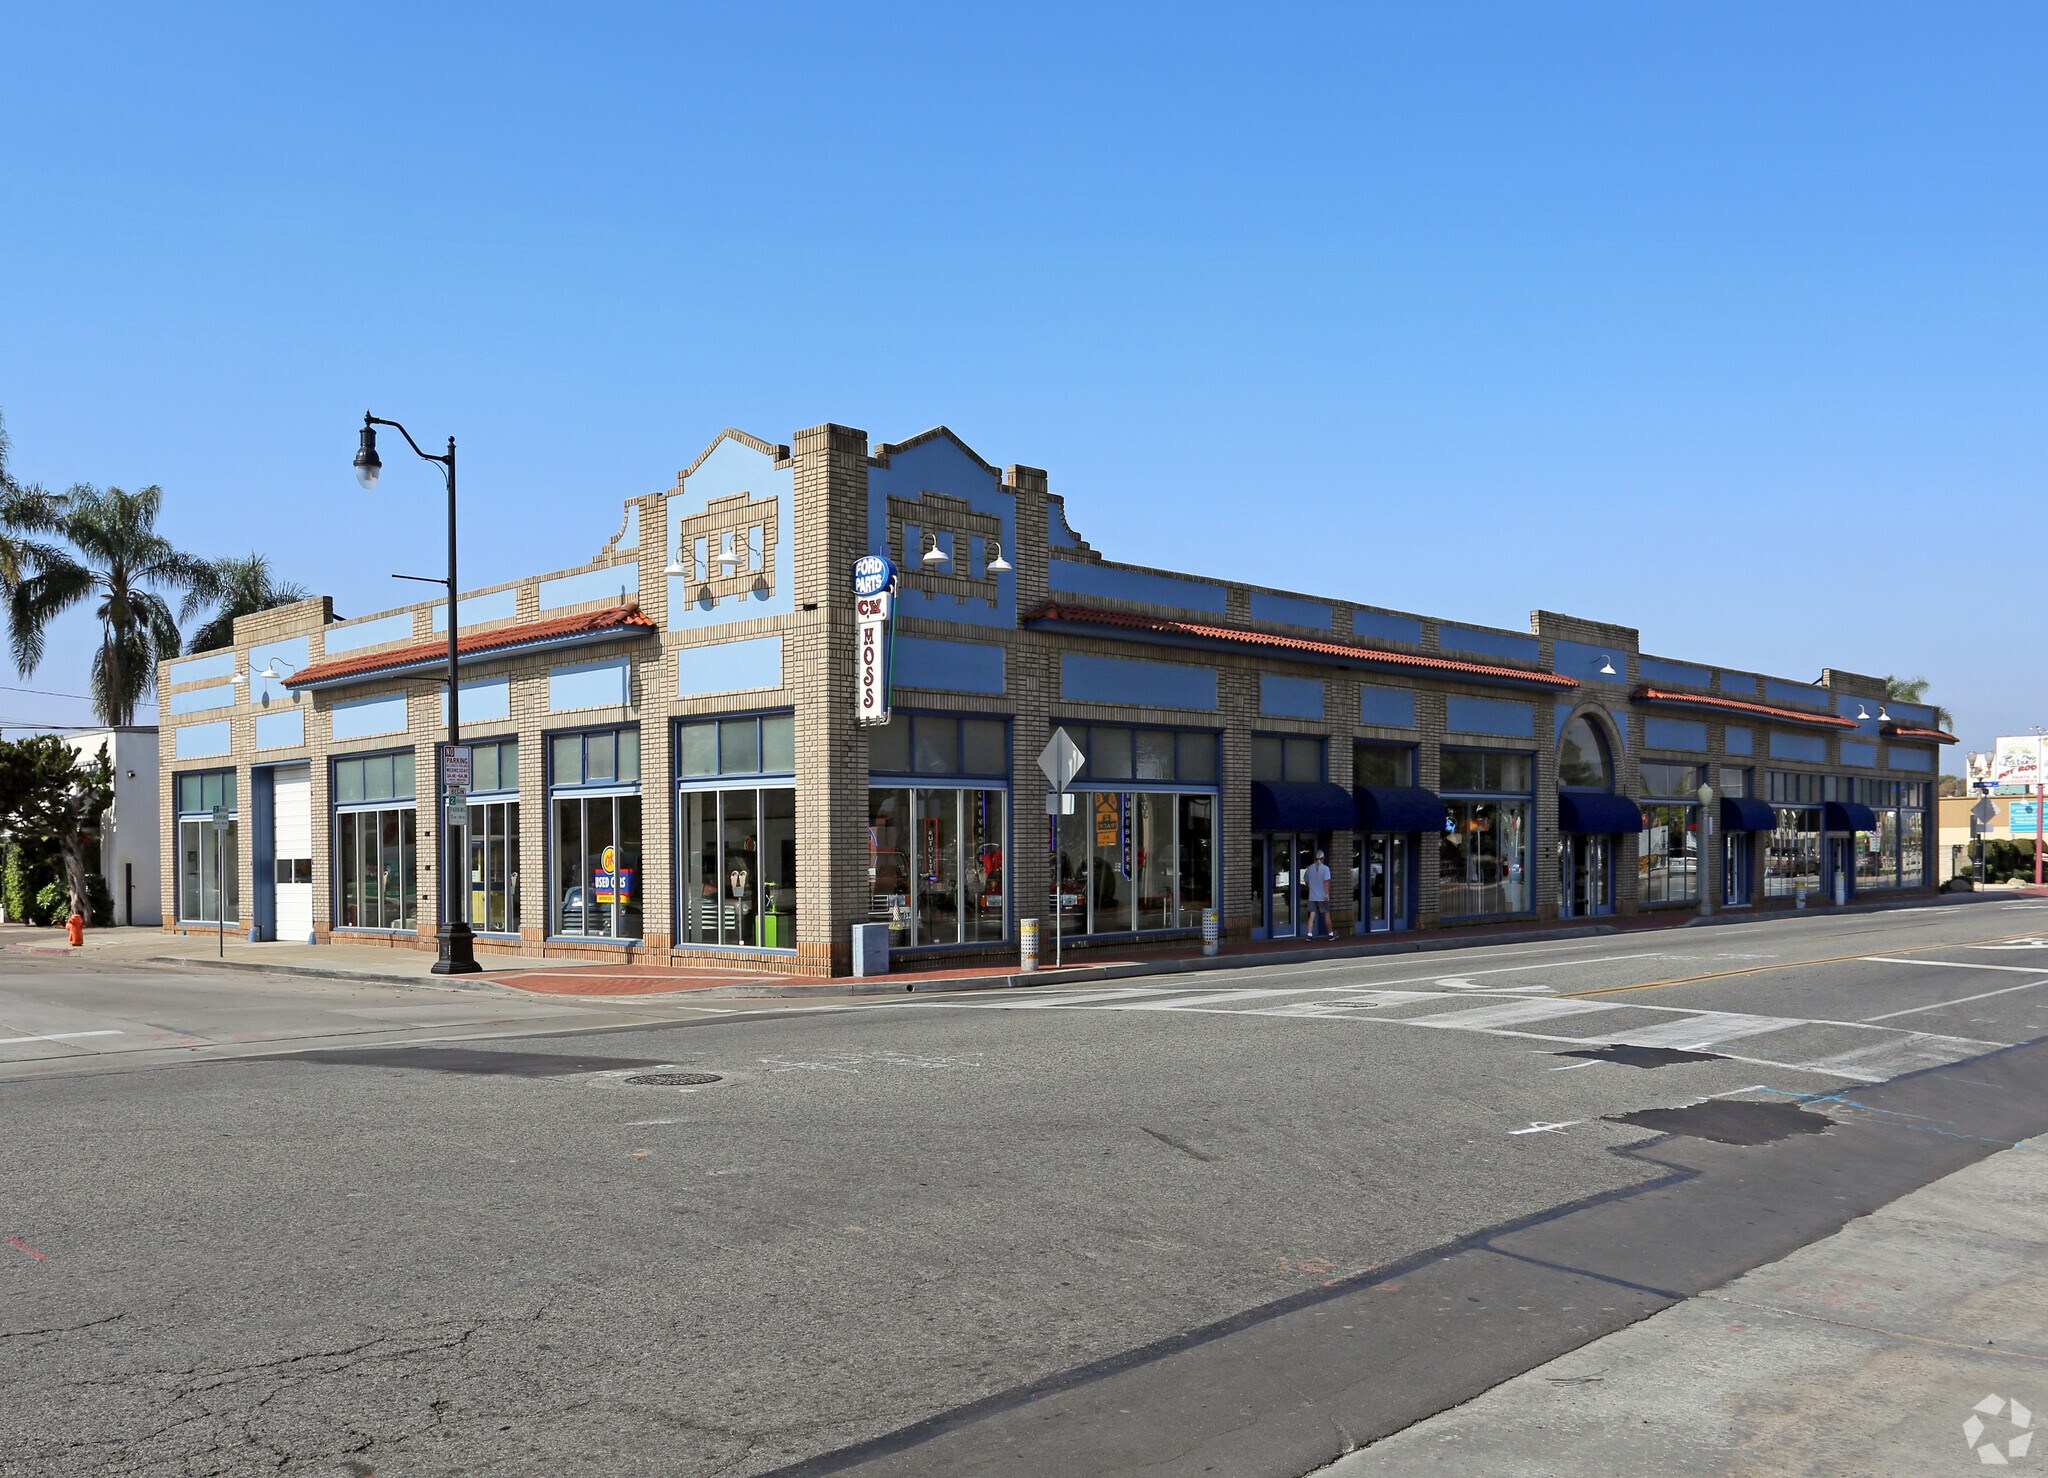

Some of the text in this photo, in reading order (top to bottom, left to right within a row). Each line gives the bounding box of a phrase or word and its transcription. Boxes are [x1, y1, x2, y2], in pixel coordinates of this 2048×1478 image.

[855, 558, 882, 576] FORD
[855, 573, 883, 594] PARTS
[446, 748, 454, 757] NO
[446, 757, 469, 765] PARKING
[594, 876, 610, 889] USED
